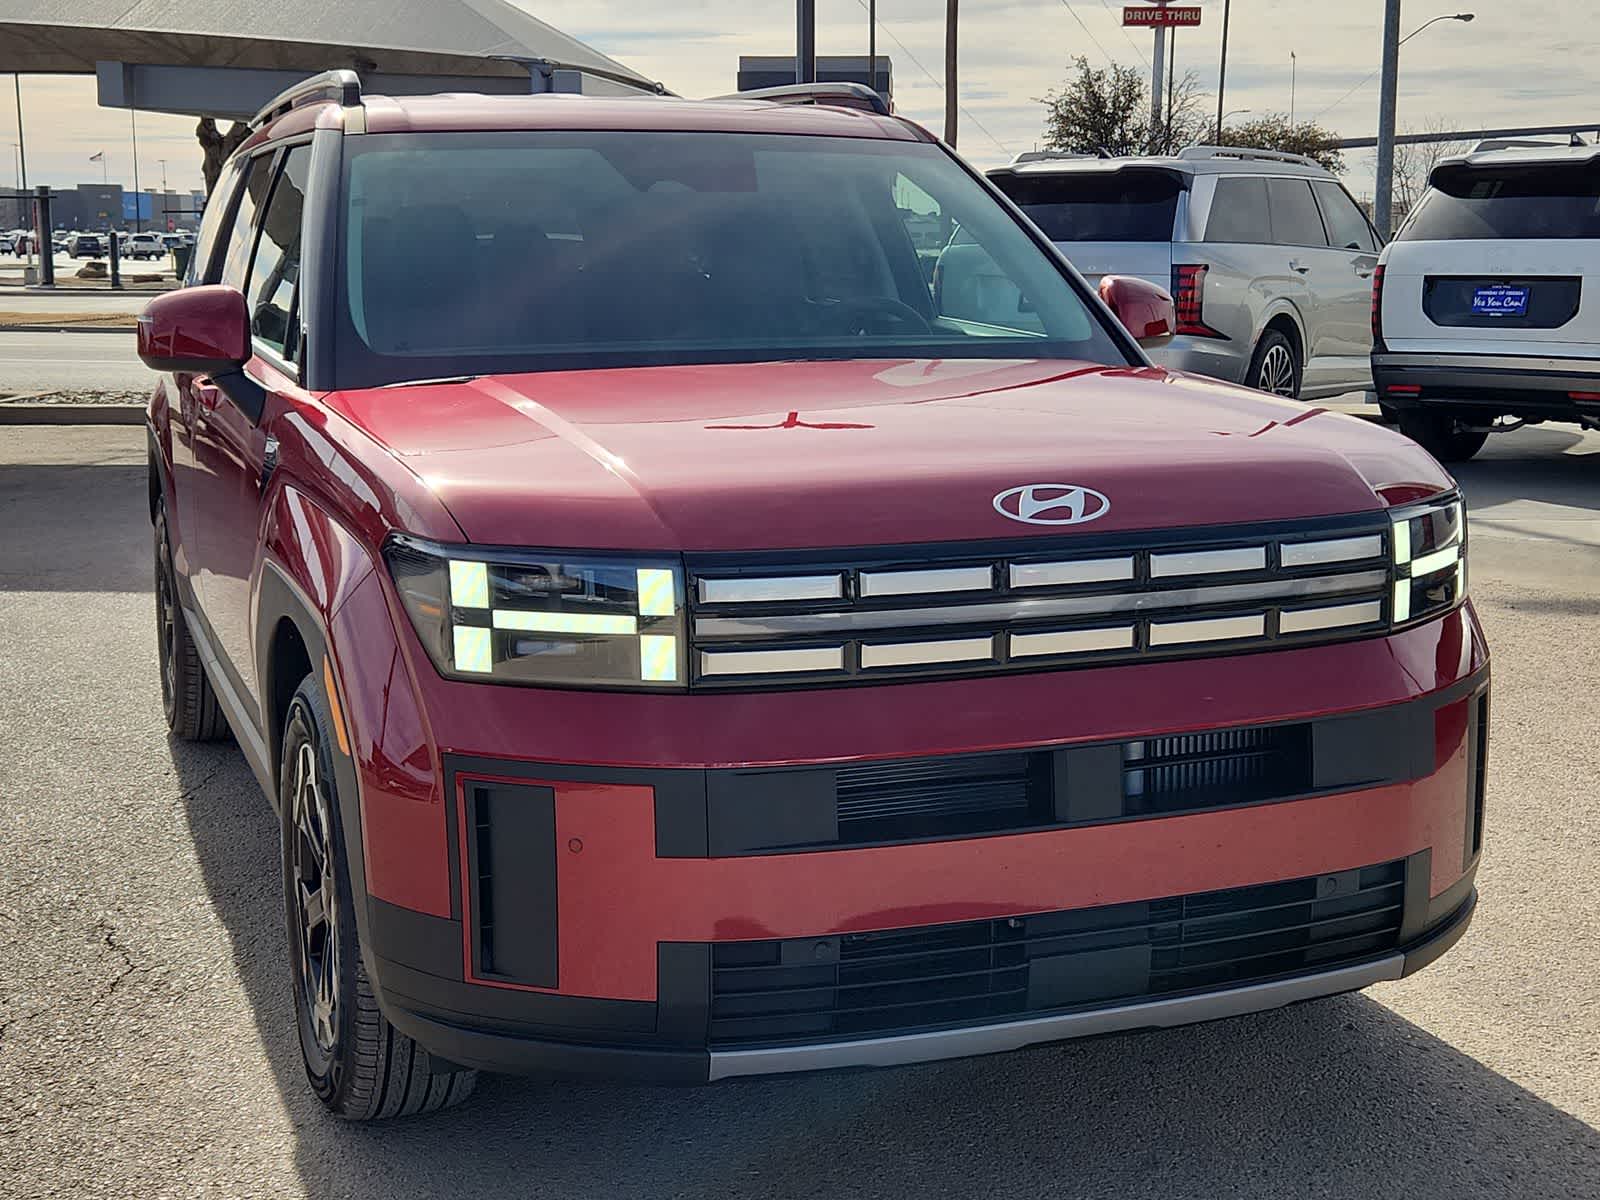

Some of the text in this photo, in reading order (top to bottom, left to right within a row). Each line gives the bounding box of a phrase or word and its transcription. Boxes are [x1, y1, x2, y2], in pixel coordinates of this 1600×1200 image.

[1125, 11, 1200, 20] DRIVE THRU
[1473, 296, 1525, 307] Yes You Can!
